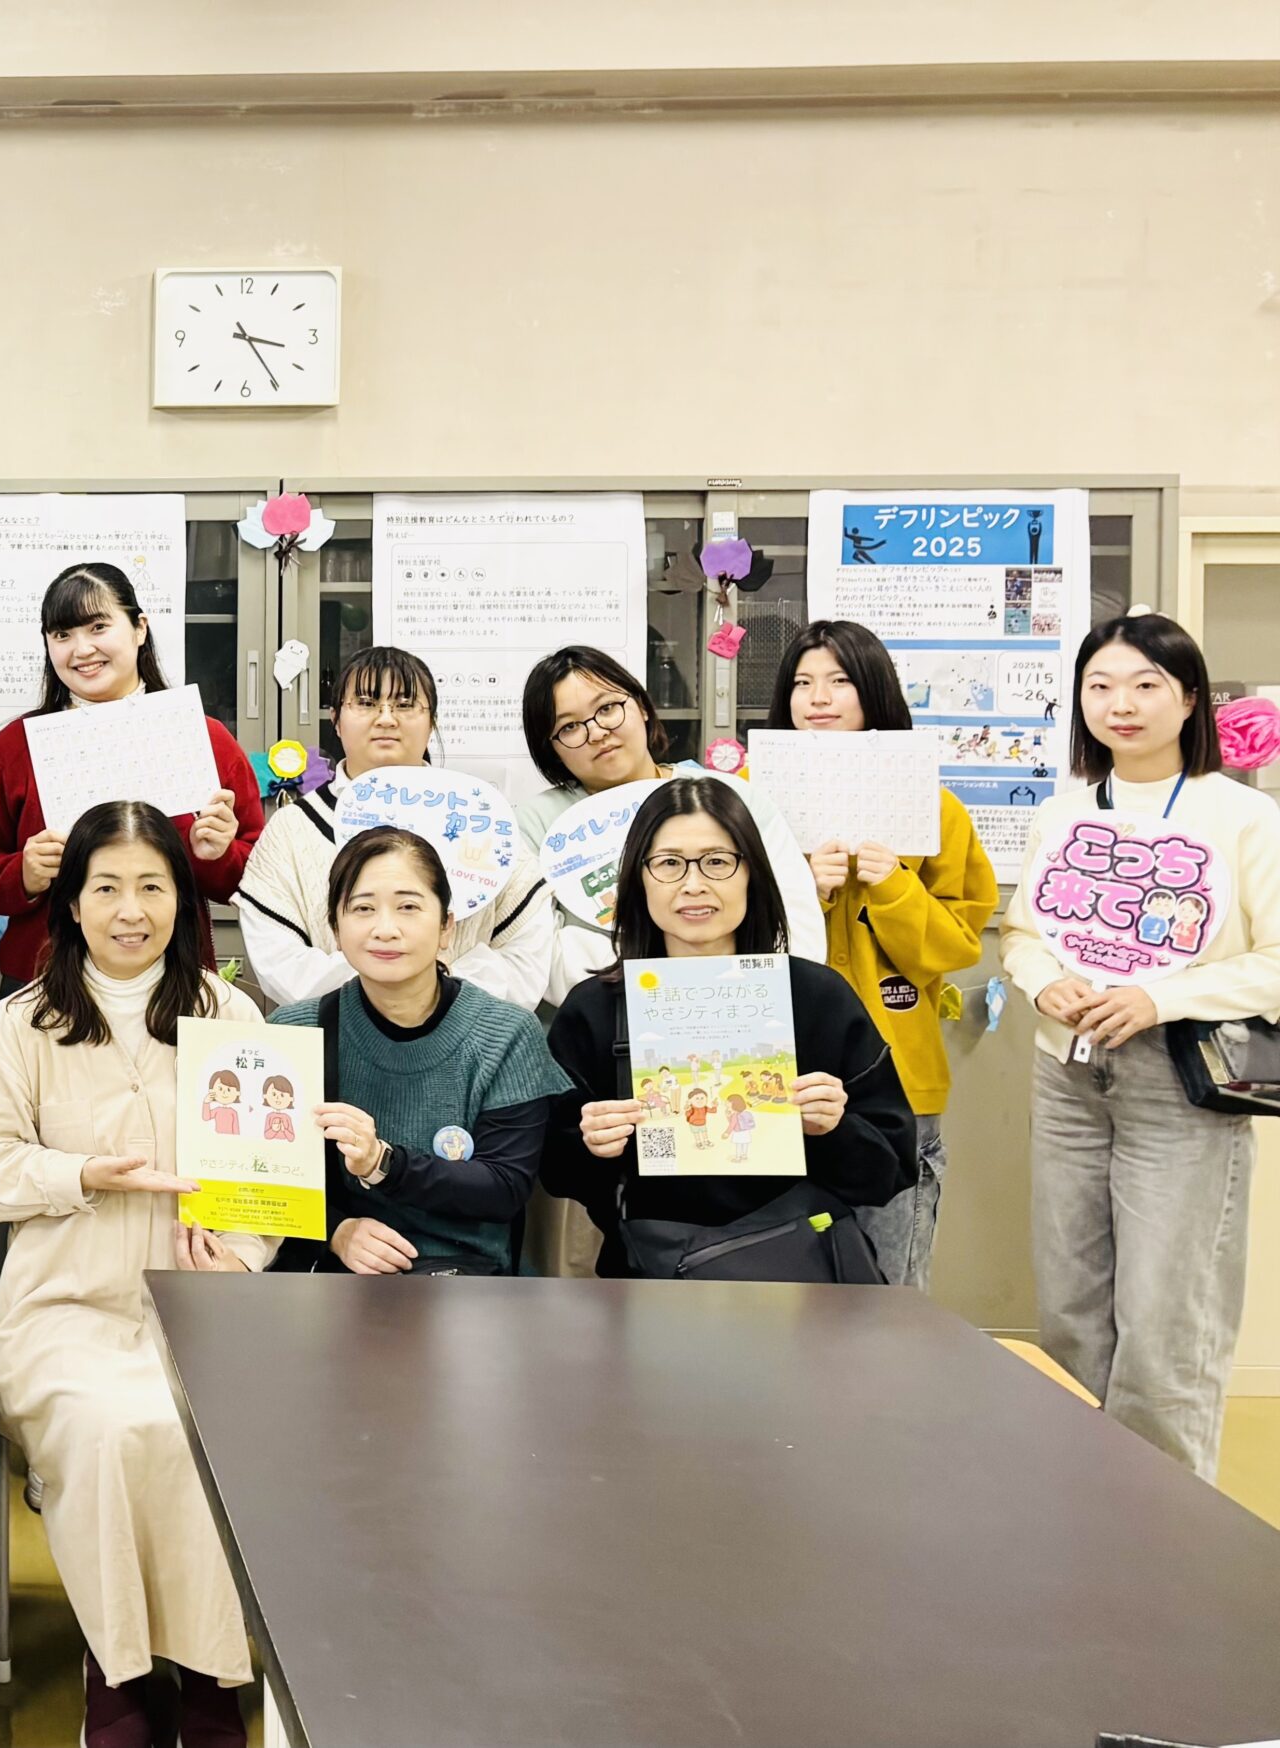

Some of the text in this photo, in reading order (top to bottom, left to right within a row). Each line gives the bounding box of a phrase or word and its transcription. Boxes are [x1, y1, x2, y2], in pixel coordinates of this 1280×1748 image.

[240, 277, 254, 294] 12
[174, 328, 319, 348] 9 3
[240, 380, 252, 398] 6
[874, 506, 1020, 530] デフリンピック
[912, 536, 983, 558] 2025
[1012, 661, 1046, 670] 2025年
[1006, 671, 1054, 687] 11/15
[352, 782, 468, 810] サイレント
[445, 812, 513, 836] カフェ
[1063, 823, 1209, 890] こっち
[451, 868, 476, 882] LOVE
[478, 876, 499, 888] YOU
[1036, 868, 1145, 930] 来て
[739, 957, 775, 970] 閲覧用
[647, 983, 768, 1004] 手話でつながる
[643, 1003, 777, 1022] やさシティまつど
[235, 1056, 265, 1070] 松戸
